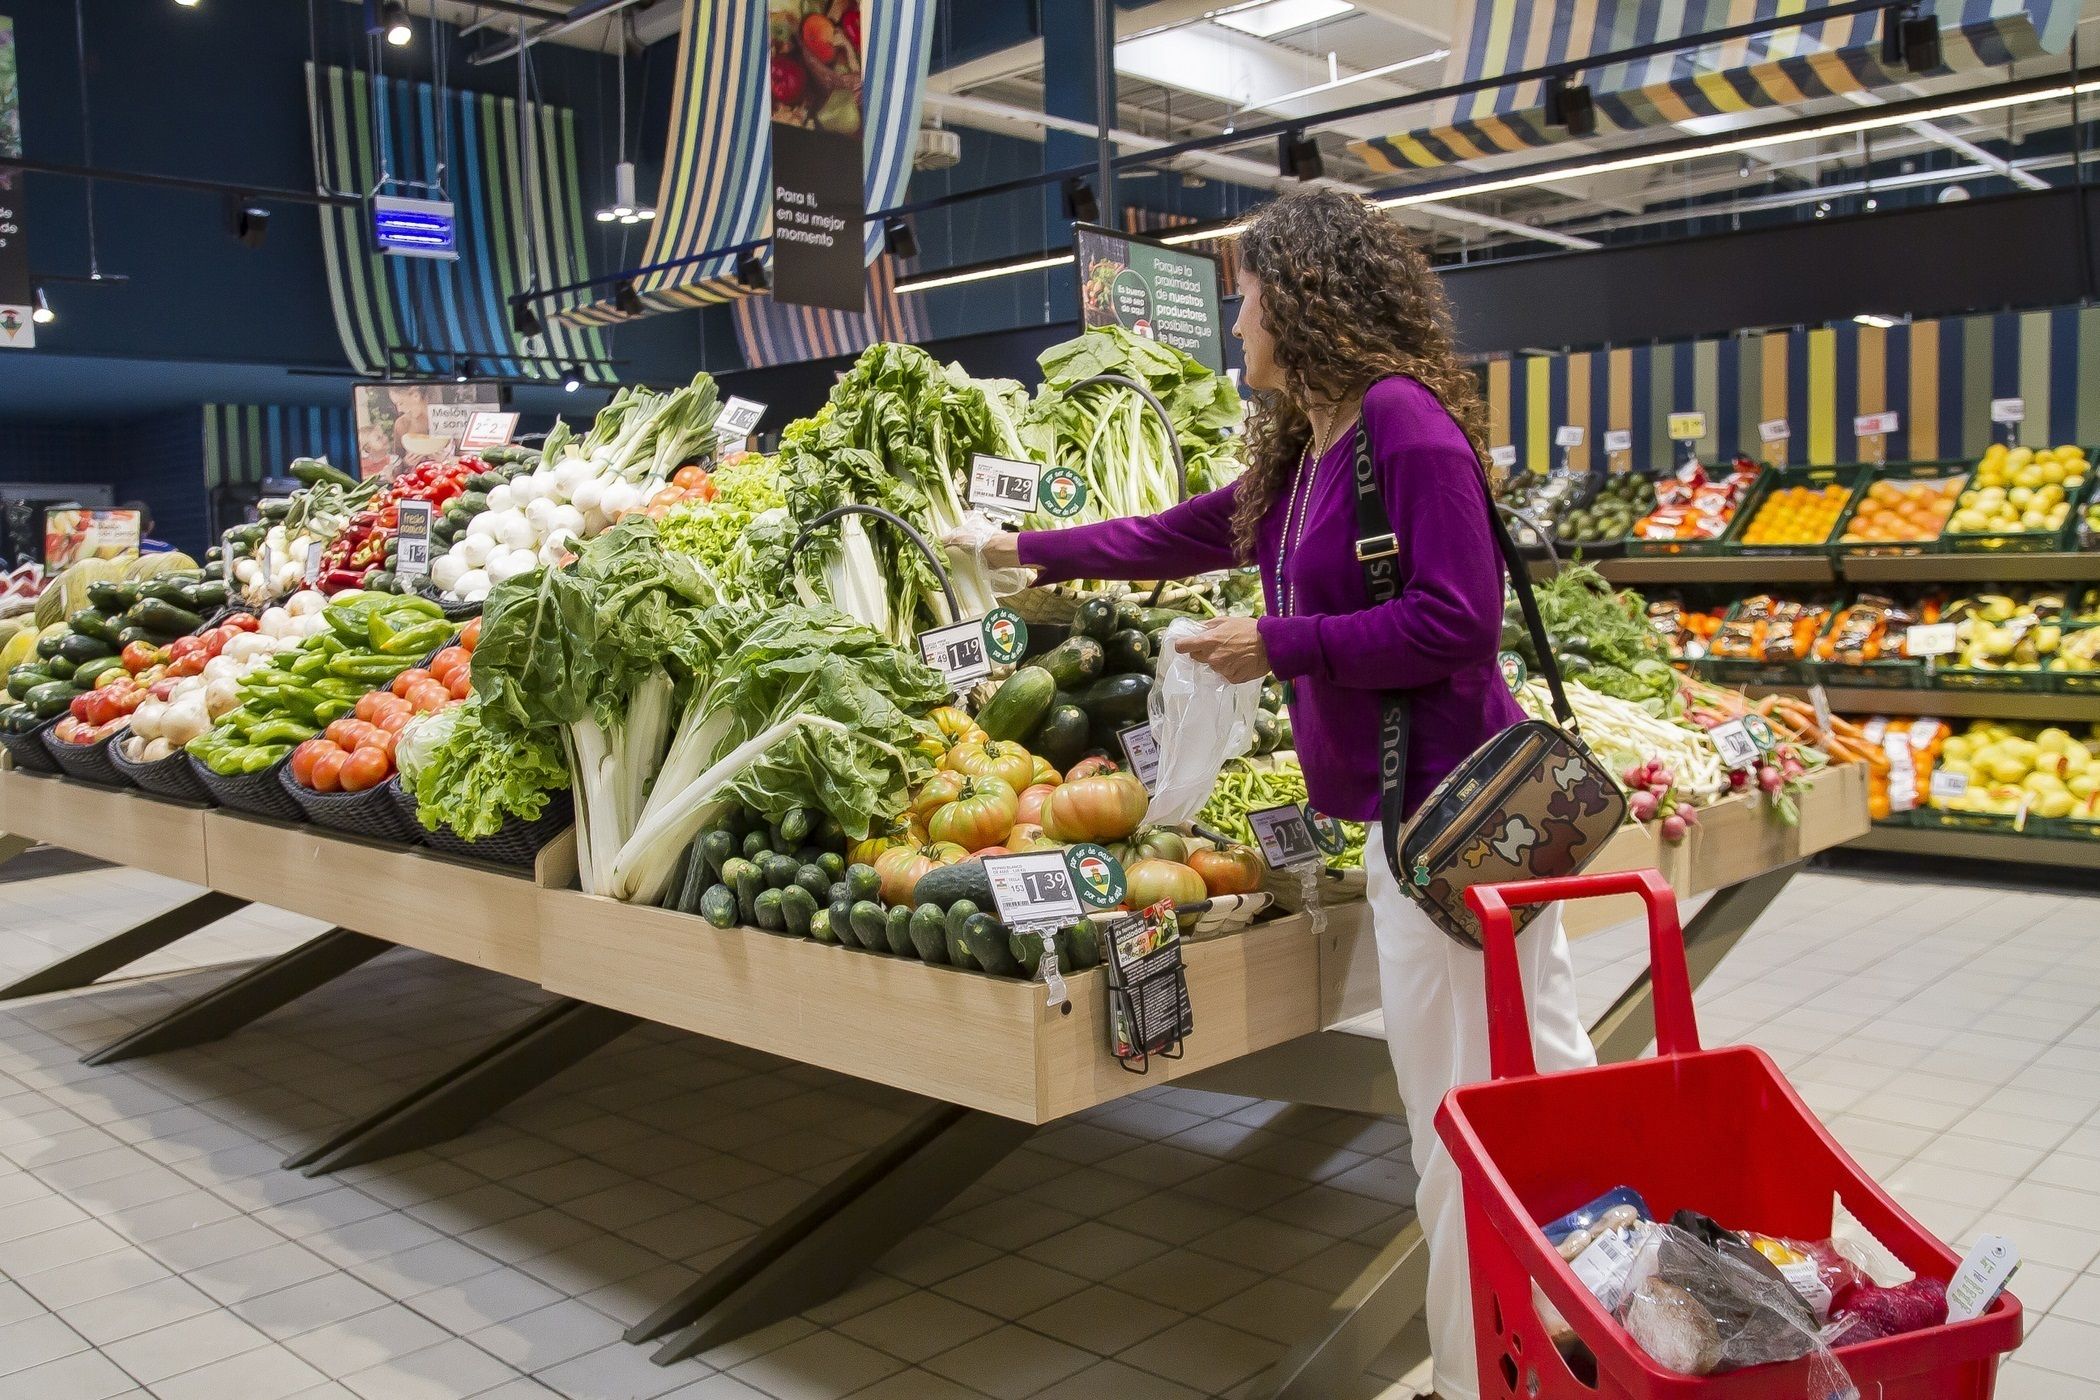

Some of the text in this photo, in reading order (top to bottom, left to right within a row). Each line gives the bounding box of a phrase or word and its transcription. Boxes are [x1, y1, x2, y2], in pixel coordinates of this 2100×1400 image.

[776, 186, 818, 208] Para ti,
[776, 208, 846, 232] en su mejor
[776, 227, 834, 248] momento
[1153, 258, 1193, 277] Porque la
[1117, 285, 1146, 298] Es bueno
[1155, 275, 1200, 293] proximidad
[1156, 288, 1204, 308] de nuestros
[1156, 304, 1207, 322] productores
[1158, 319, 1212, 338] posibilita que
[1168, 333, 1200, 349] lleguen
[432, 406, 468, 417] Melón
[998, 476, 1032, 498] 1,29
[937, 653, 948, 663] 49
[949, 638, 979, 670] 1,19
[1383, 707, 1401, 796] TOUS
[1070, 846, 1114, 869] por ser de aquí
[1010, 884, 1025, 893] 153
[1026, 872, 1066, 902] 1,39
[1083, 890, 1096, 900] por
[1108, 895, 1116, 904] de
[1114, 884, 1123, 900] aquí
